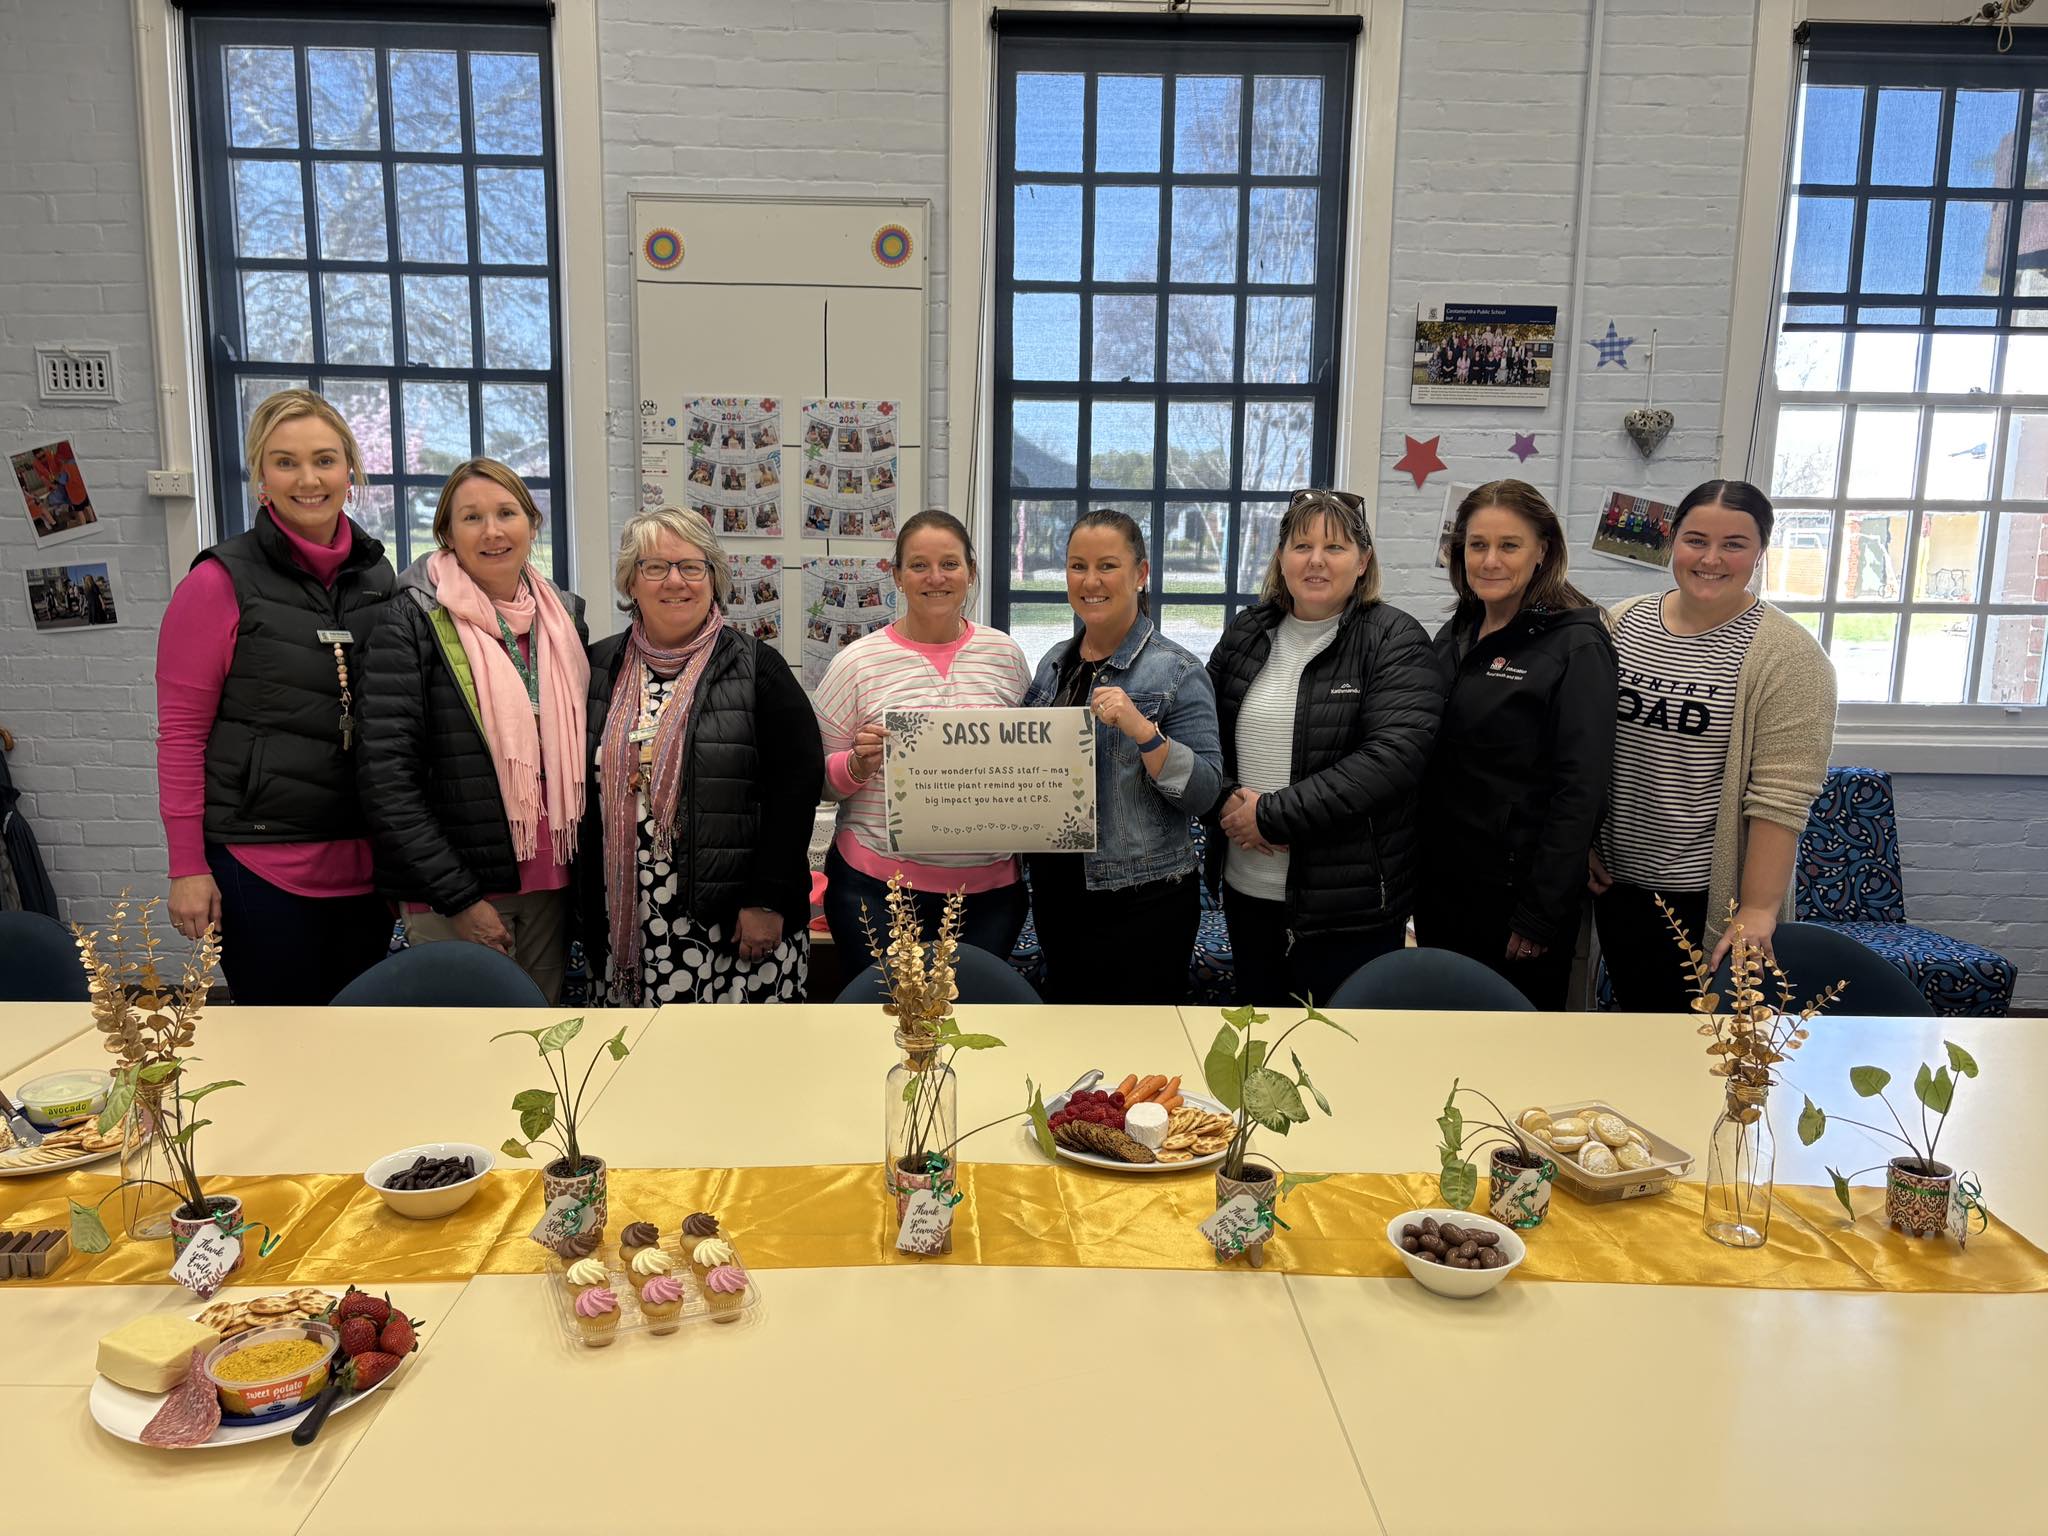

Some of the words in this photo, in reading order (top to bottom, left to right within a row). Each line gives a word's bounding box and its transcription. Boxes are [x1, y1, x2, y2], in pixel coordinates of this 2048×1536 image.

[721, 412, 743, 422] 2024
[839, 416, 860, 424] 2024
[838, 572, 859, 581] 2024
[1617, 668, 1720, 699] OUNTRY
[1617, 688, 1710, 736] OAD
[942, 722, 990, 746] SASS
[1000, 720, 1052, 744] WEEK
[908, 768, 921, 776] To
[922, 768, 938, 776] our
[940, 766, 986, 776] wonderful
[988, 767, 1014, 775] SASS
[1017, 766, 1040, 774] staff
[1050, 767, 1069, 776] may
[914, 782, 932, 790] this
[934, 781, 956, 790] little
[958, 781, 982, 792] plant
[984, 780, 1016, 789] remind
[1018, 782, 1034, 791] you
[1036, 780, 1046, 788] of
[1048, 780, 1064, 788] the
[925, 796, 938, 806] big
[940, 795, 972, 806] impact
[974, 796, 990, 806] you
[992, 795, 1014, 803] have
[1016, 795, 1028, 803] at
[1030, 794, 1052, 803] CPS.
[48, 1103, 87, 1115] avocado
[912, 1202, 940, 1216] Thank
[910, 1217, 928, 1227] you
[1218, 1214, 1238, 1228] you
[1228, 1206, 1256, 1227] Thank
[196, 1238, 226, 1257] Thank
[189, 1251, 210, 1263] you
[186, 1258, 214, 1279] Emily
[246, 1390, 270, 1400] sweet
[273, 1380, 304, 1397] potato
